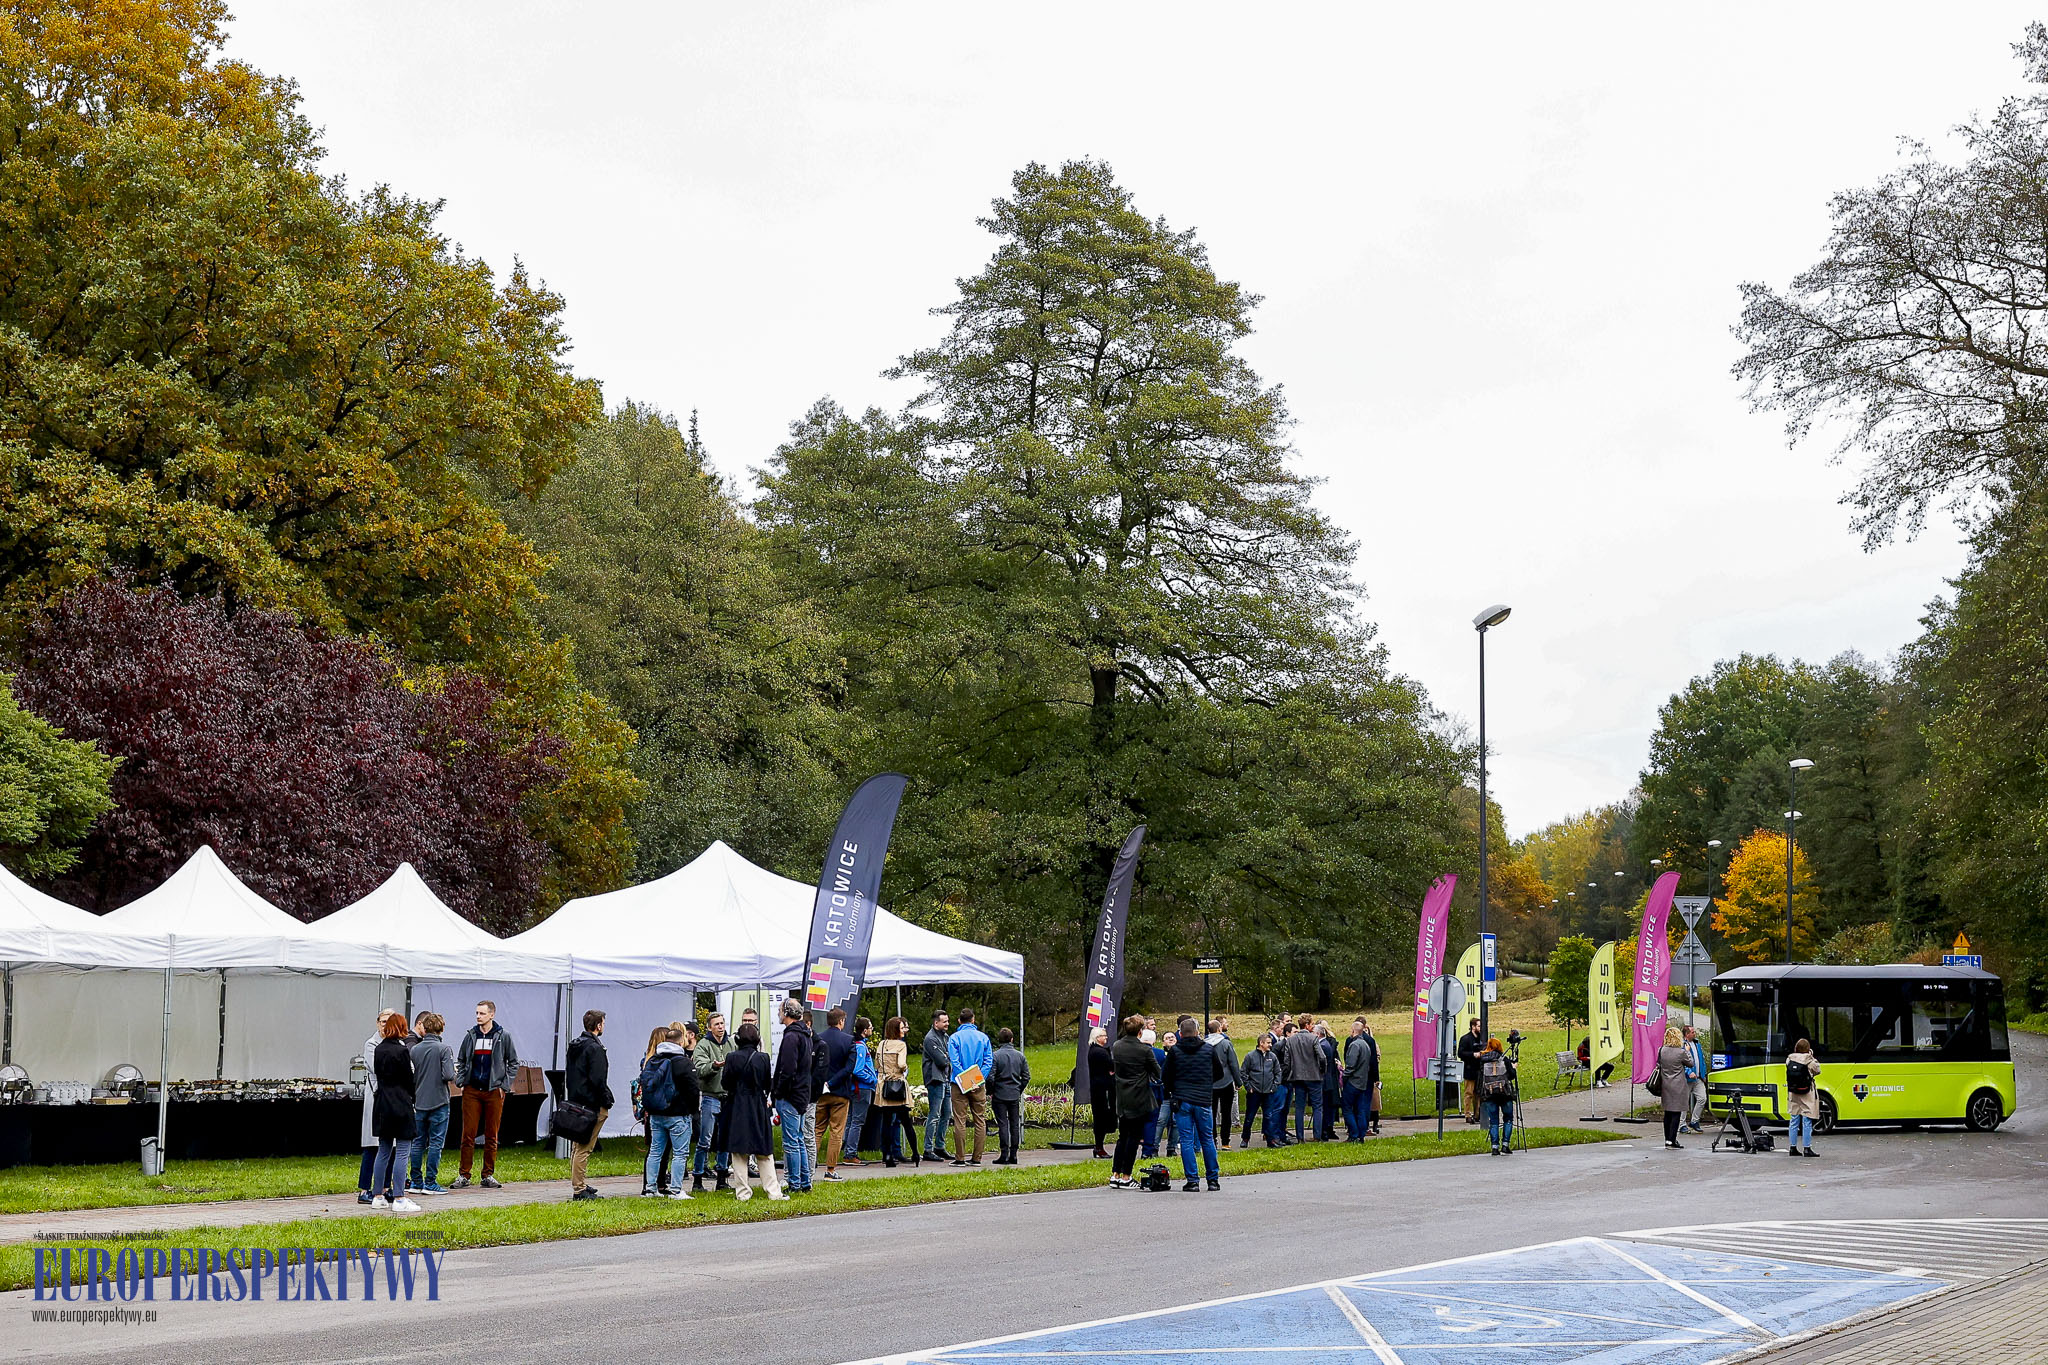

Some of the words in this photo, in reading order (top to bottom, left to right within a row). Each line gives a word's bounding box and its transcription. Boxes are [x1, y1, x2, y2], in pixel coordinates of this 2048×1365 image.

[823, 839, 858, 947] KATOWICE
[848, 889, 865, 932] odmiany
[843, 932, 855, 950] dla
[1110, 926, 1119, 964] odmiany
[1422, 915, 1436, 983] KATOWICE
[1641, 914, 1657, 985] KATOWICE
